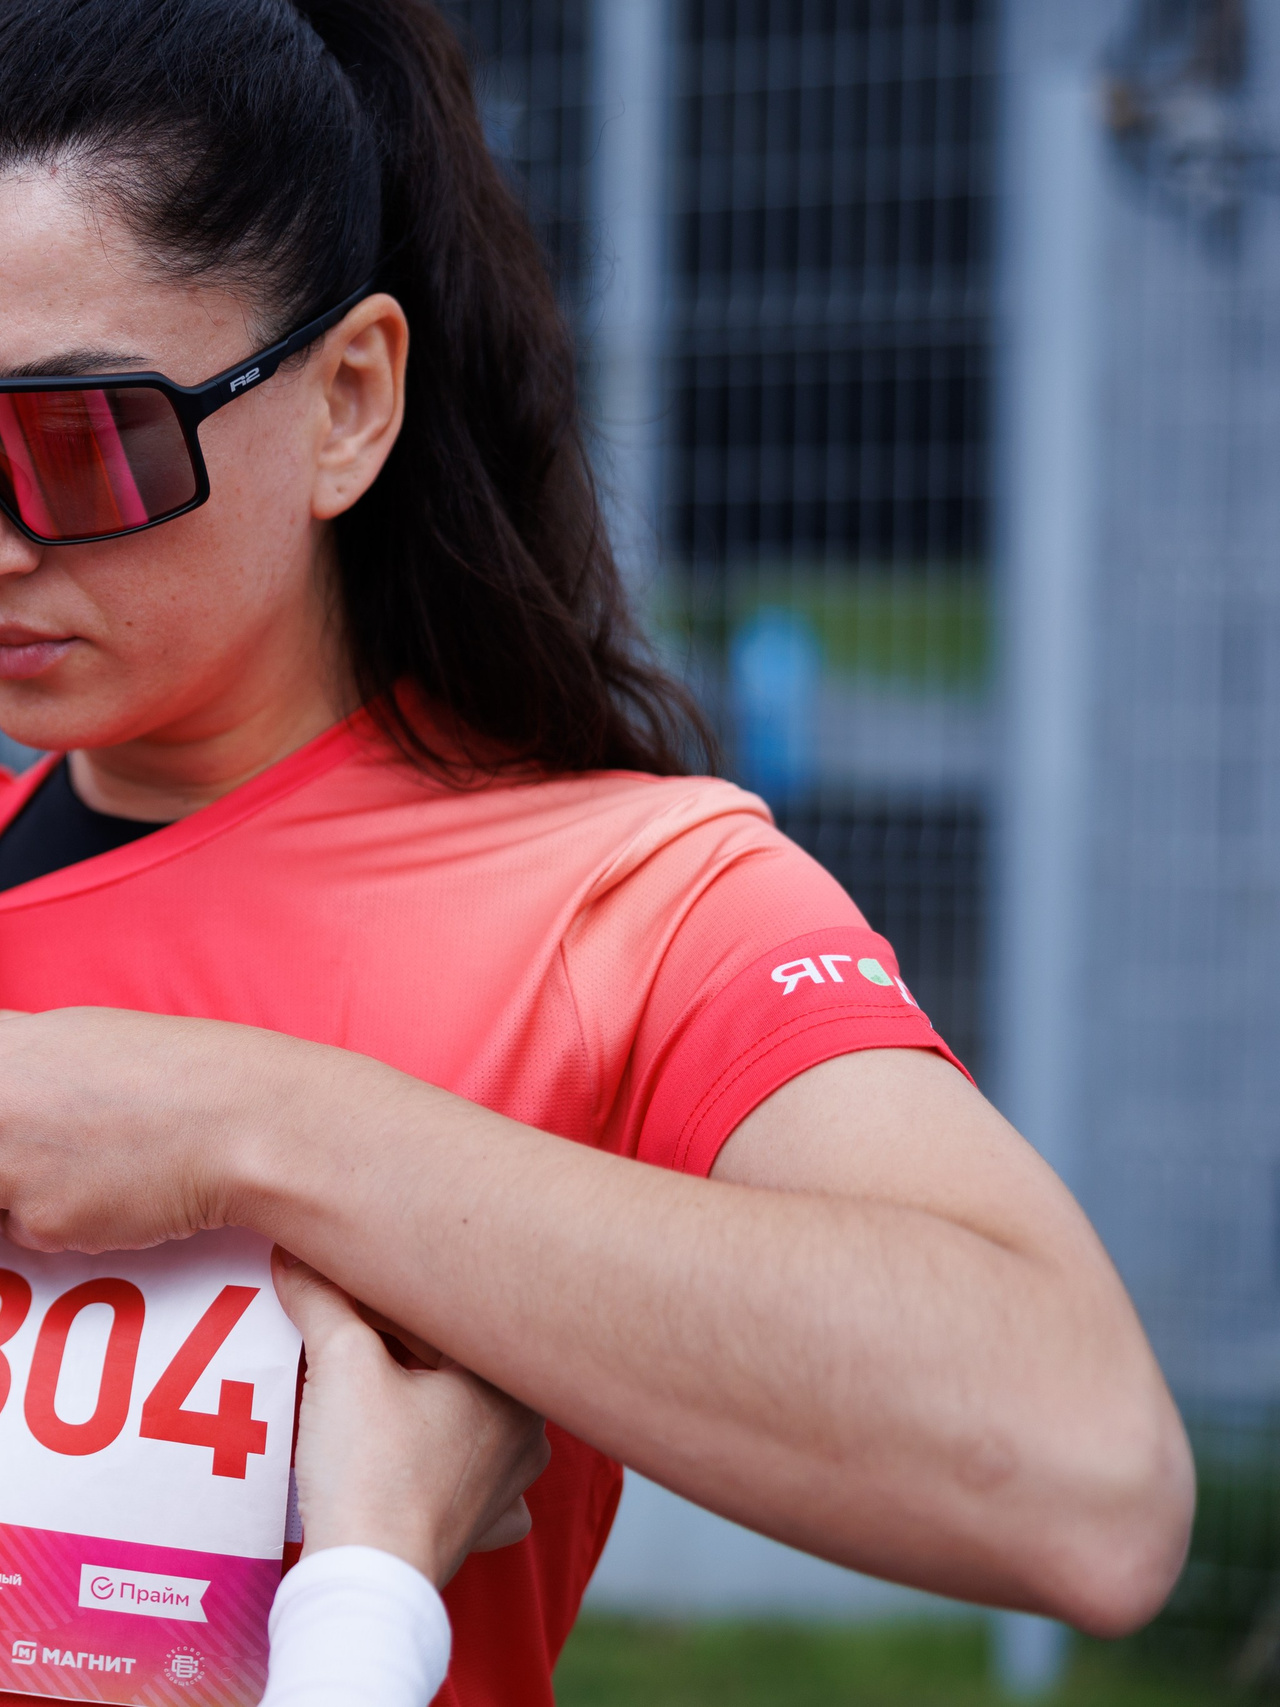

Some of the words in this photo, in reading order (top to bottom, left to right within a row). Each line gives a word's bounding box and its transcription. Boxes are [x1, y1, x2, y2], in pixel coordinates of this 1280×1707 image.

[120, 1582, 190, 1607] Прайм
[41, 1647, 136, 1675] МАГНИТ
[166, 1645, 206, 1661] БЕГОВОЕ
[163, 1667, 206, 1687] СООБЩЕСТВО
